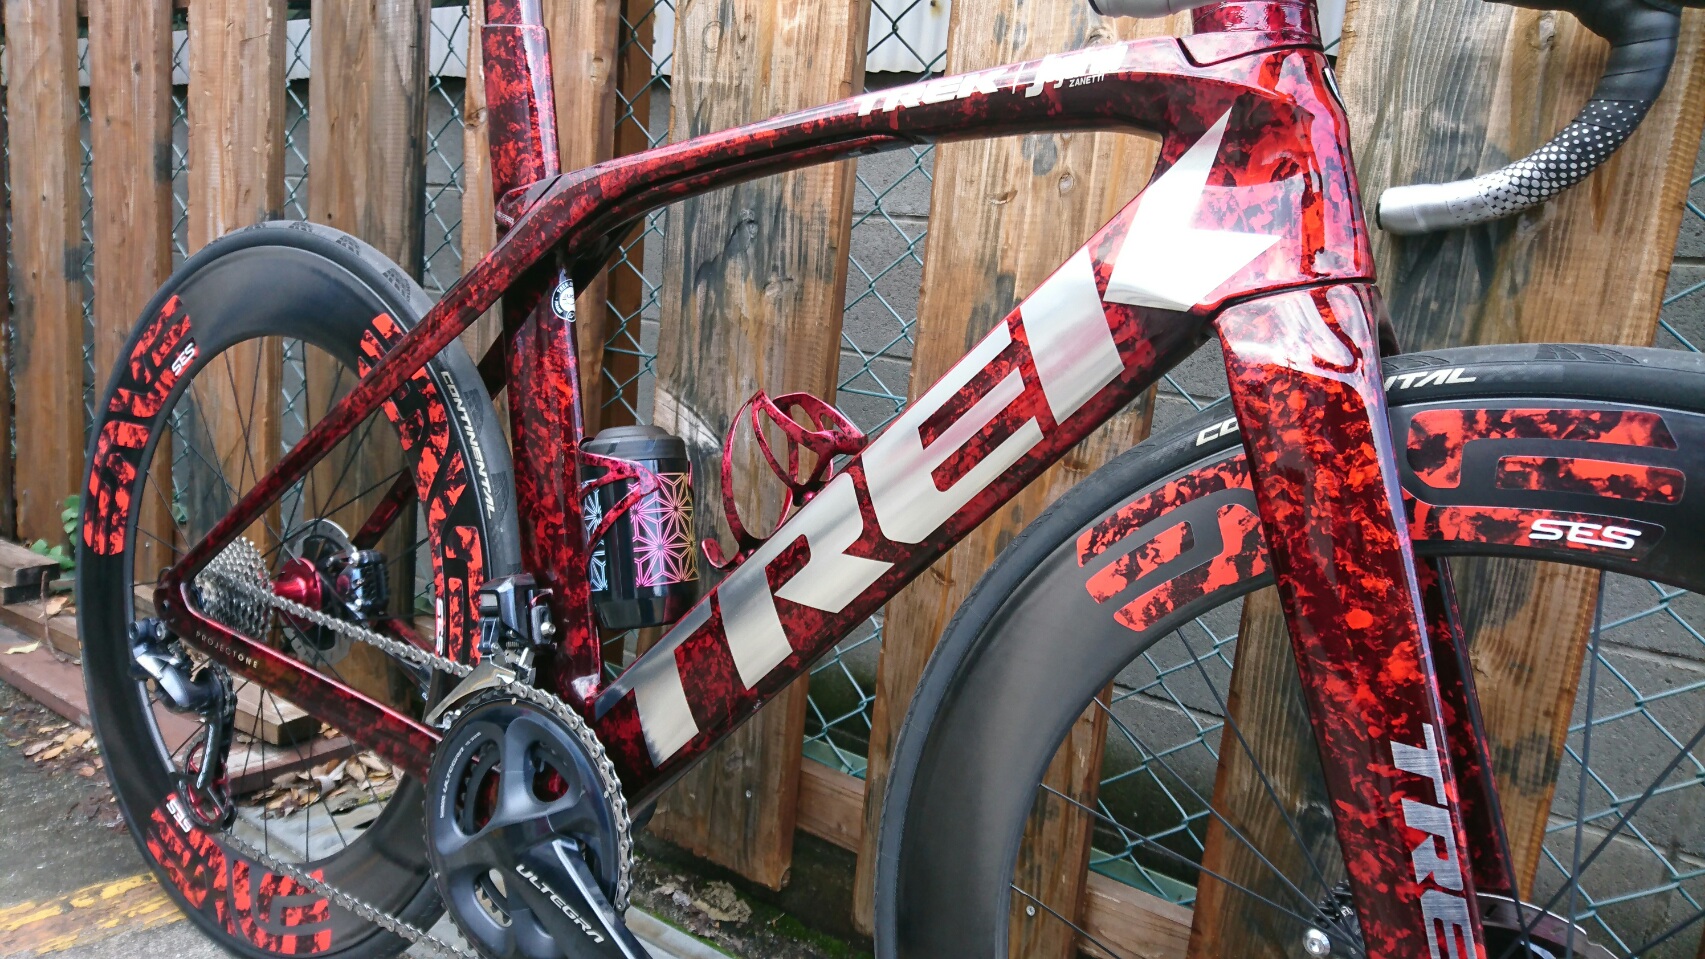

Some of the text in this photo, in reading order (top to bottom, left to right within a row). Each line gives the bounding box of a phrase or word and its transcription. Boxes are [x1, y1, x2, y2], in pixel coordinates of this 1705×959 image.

[853, 68, 1008, 116] TREK
[1069, 72, 1105, 88] ZANETTI
[171, 342, 196, 377] SES
[441, 370, 496, 520] CONTINENTAL
[594, 106, 1282, 768] TREK
[1528, 519, 1642, 550] SES
[516, 864, 604, 943] ULTEGRA
